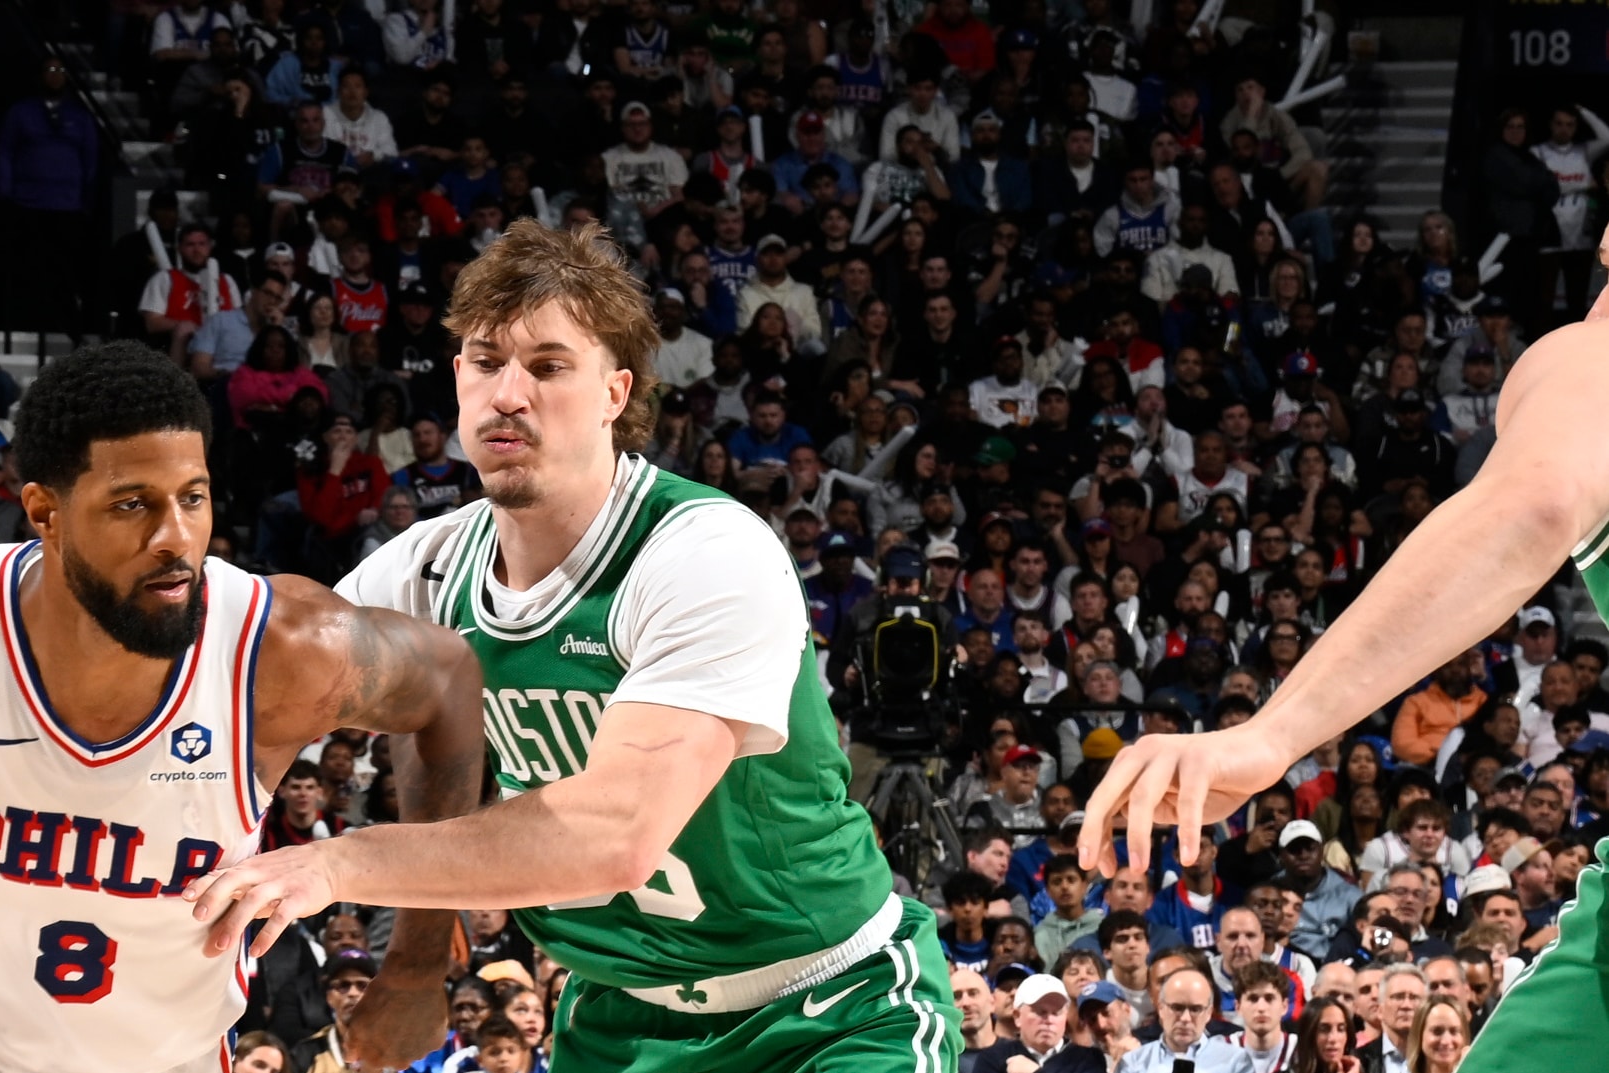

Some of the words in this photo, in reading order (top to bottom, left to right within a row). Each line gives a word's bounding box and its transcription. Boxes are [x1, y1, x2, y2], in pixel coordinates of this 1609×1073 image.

[1510, 28, 1571, 66] 108
[560, 633, 609, 656] Amica
[149, 769, 227, 783] crypto.com
[34, 919, 118, 1004] 8
